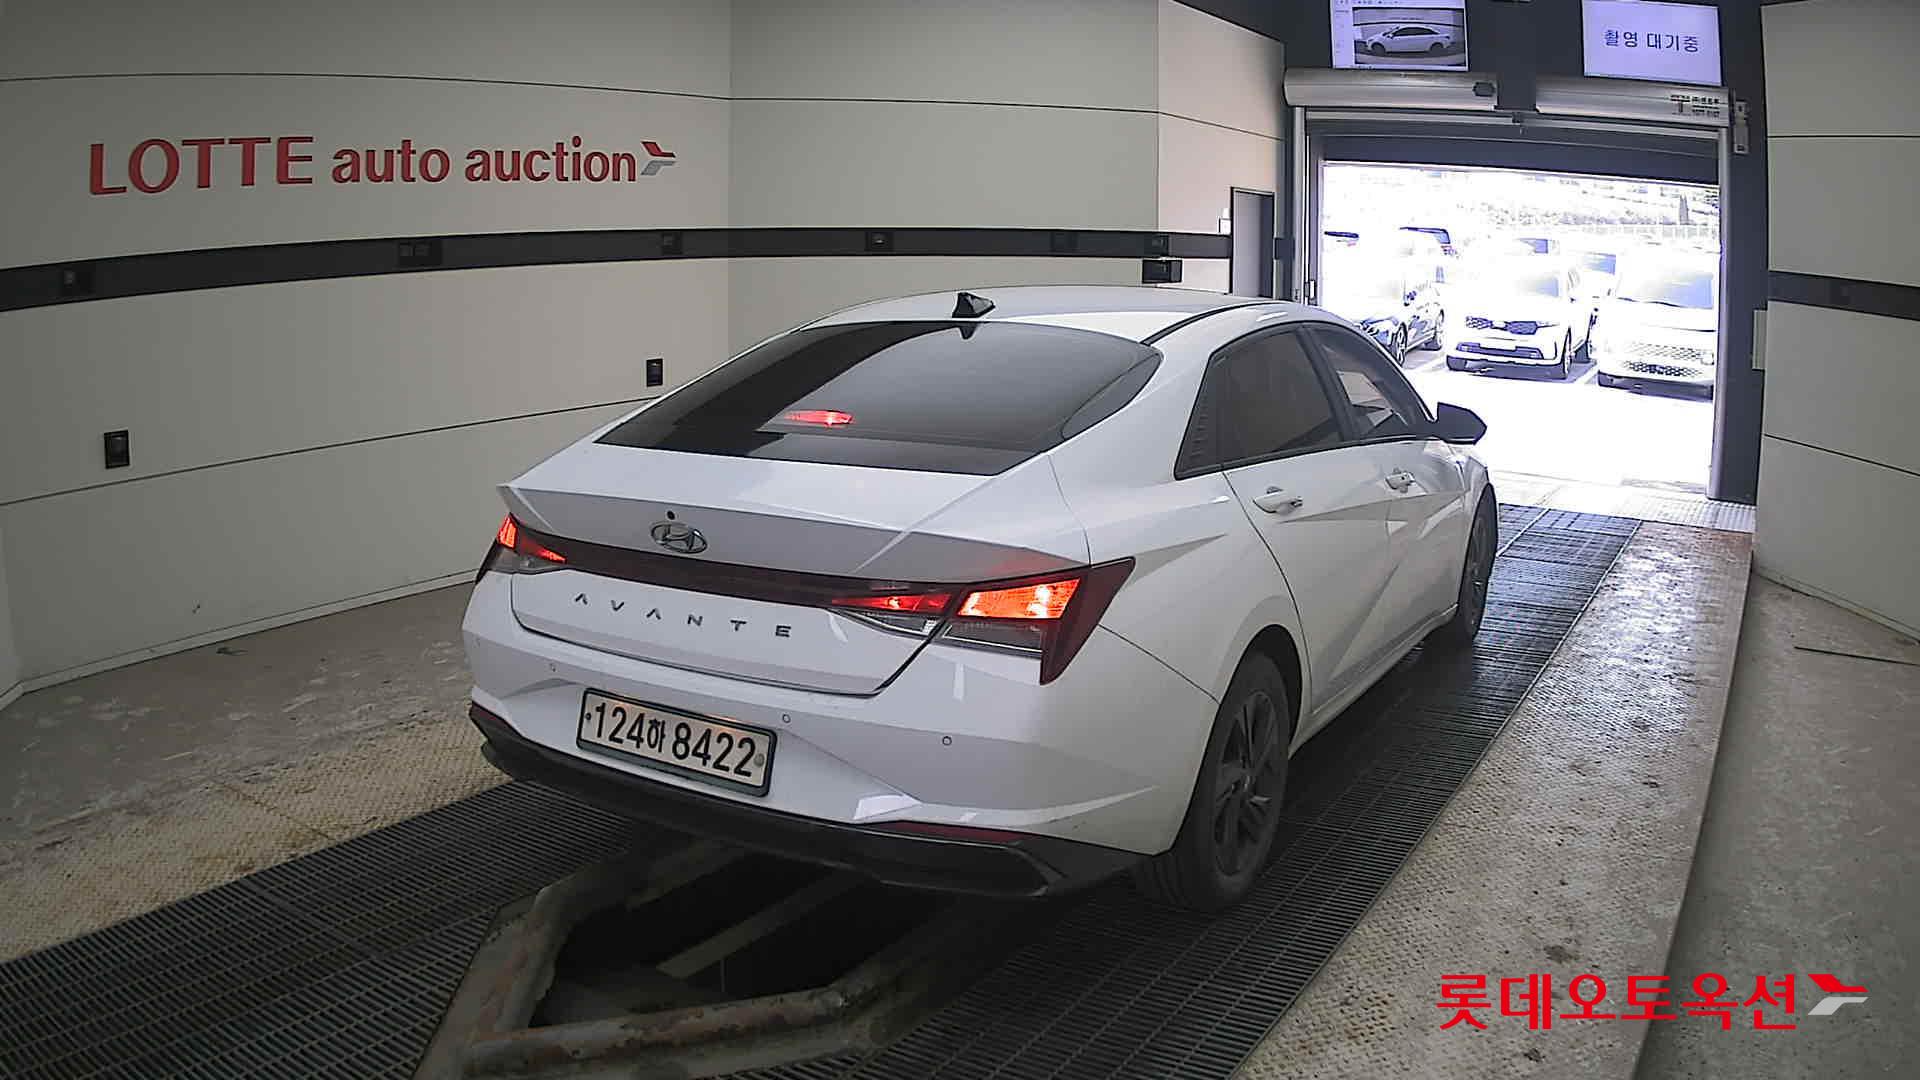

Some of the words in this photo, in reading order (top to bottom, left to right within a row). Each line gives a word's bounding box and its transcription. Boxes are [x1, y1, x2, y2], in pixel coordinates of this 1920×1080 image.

[1646, 33, 1699, 53] 대기중
[89, 136, 314, 195] LOTTE
[331, 139, 451, 183] auto
[464, 135, 636, 182] auction
[575, 592, 792, 638] AVANTE
